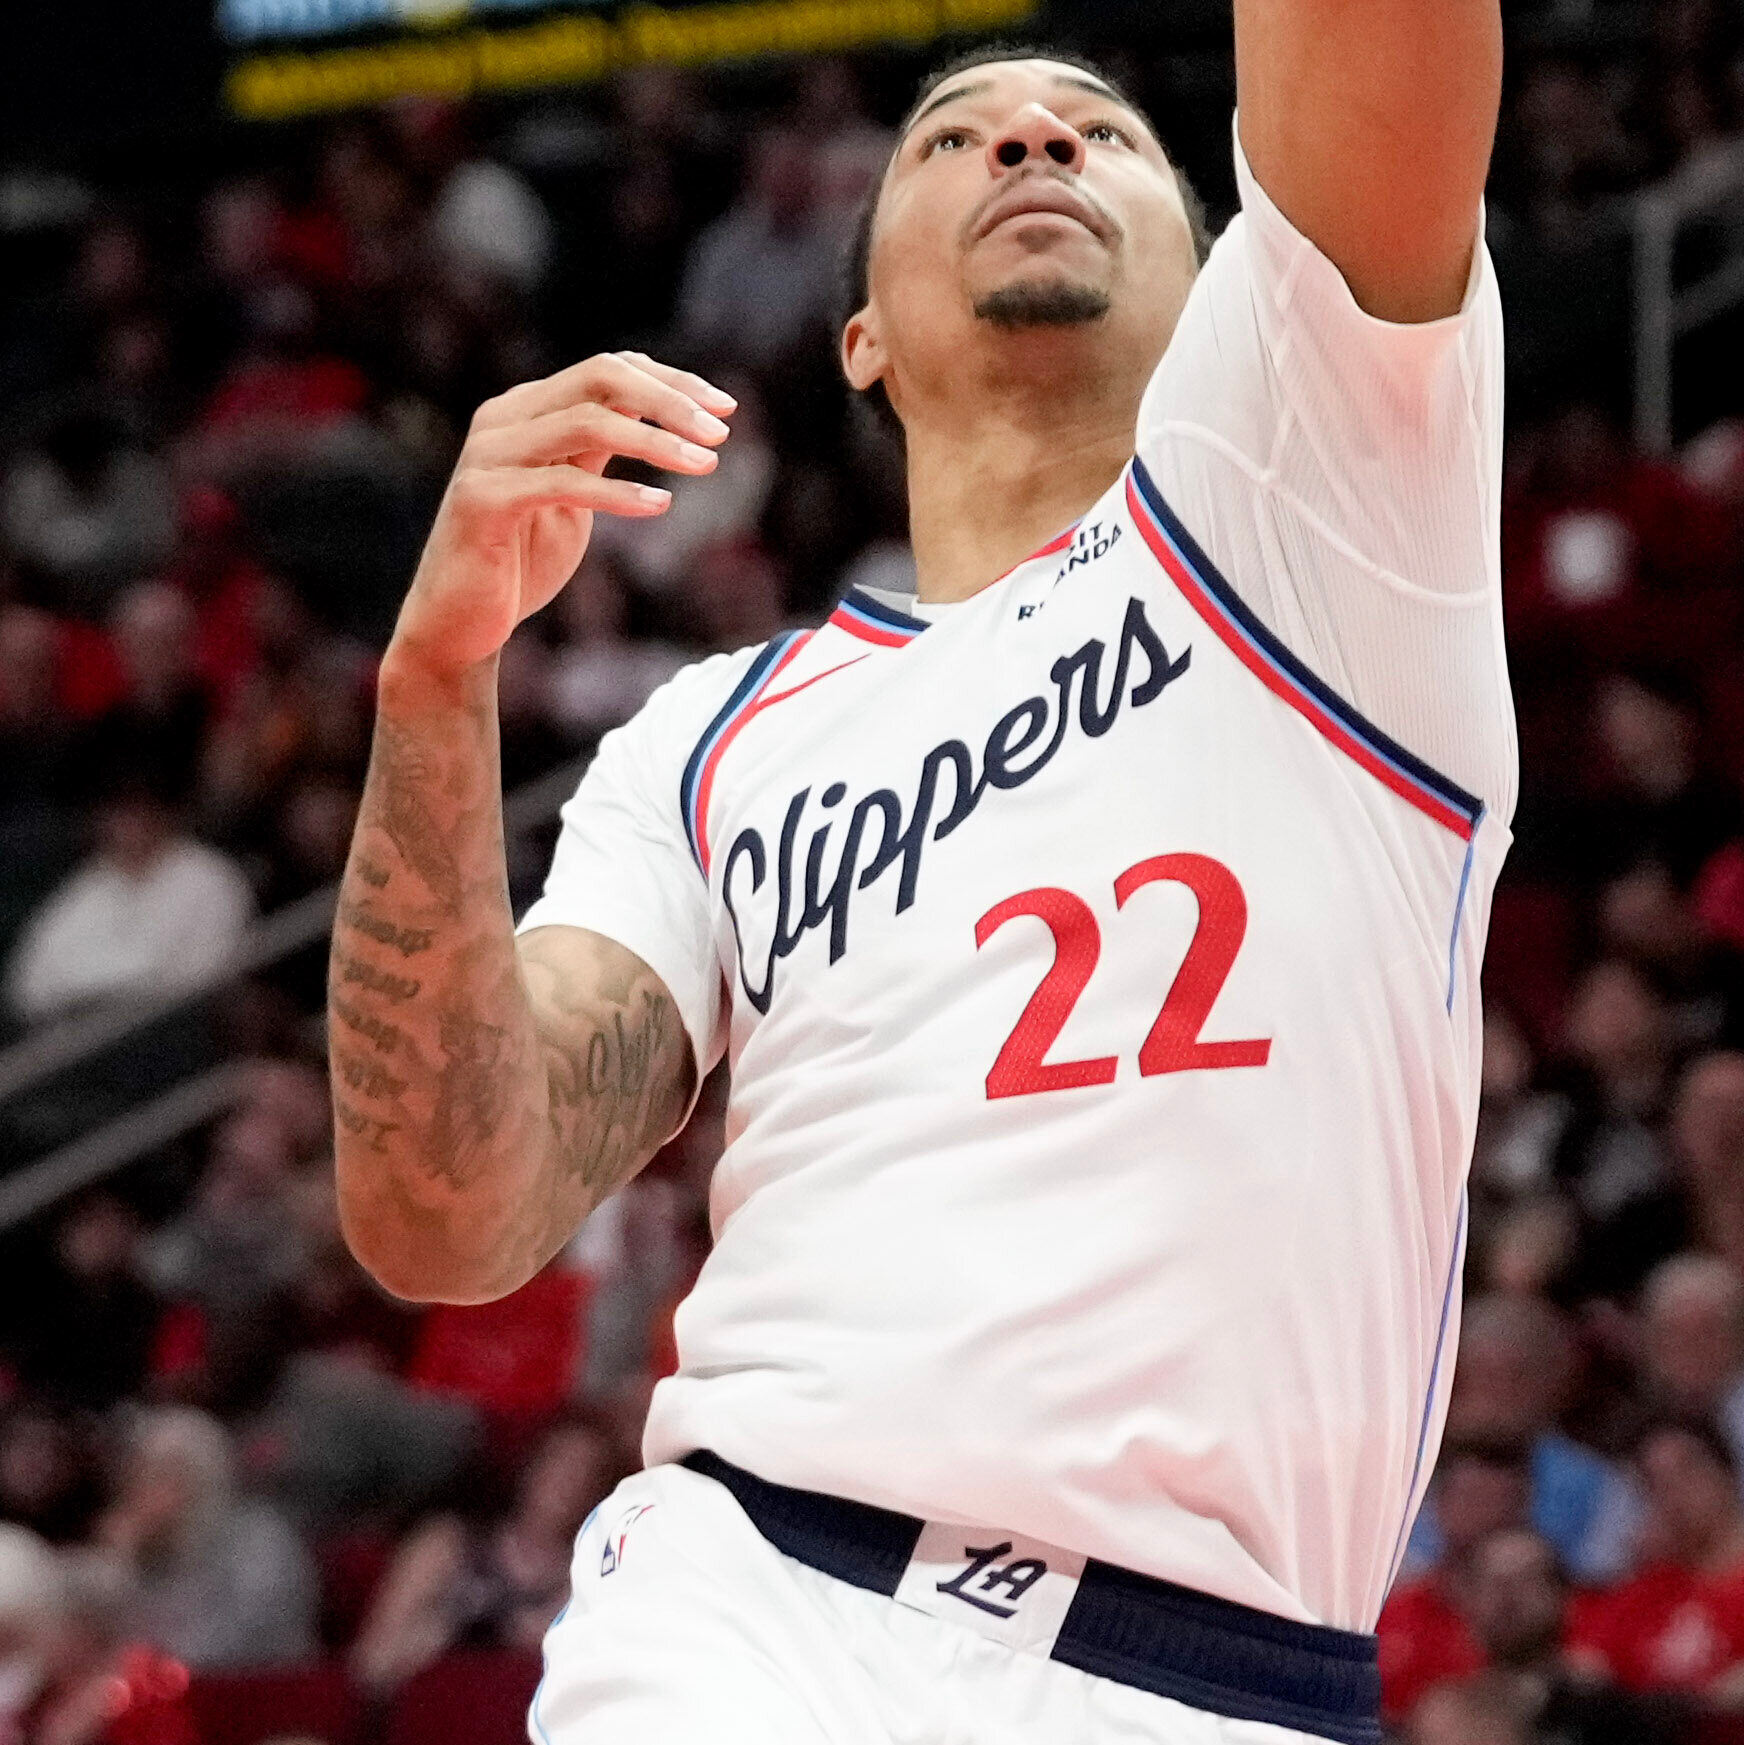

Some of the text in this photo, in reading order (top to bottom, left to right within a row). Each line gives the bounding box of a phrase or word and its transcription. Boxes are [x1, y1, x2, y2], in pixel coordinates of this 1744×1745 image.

[722, 595, 1192, 1016] Clippers
[974, 851, 1273, 1101] 22
[936, 1540, 1048, 1620] LA
